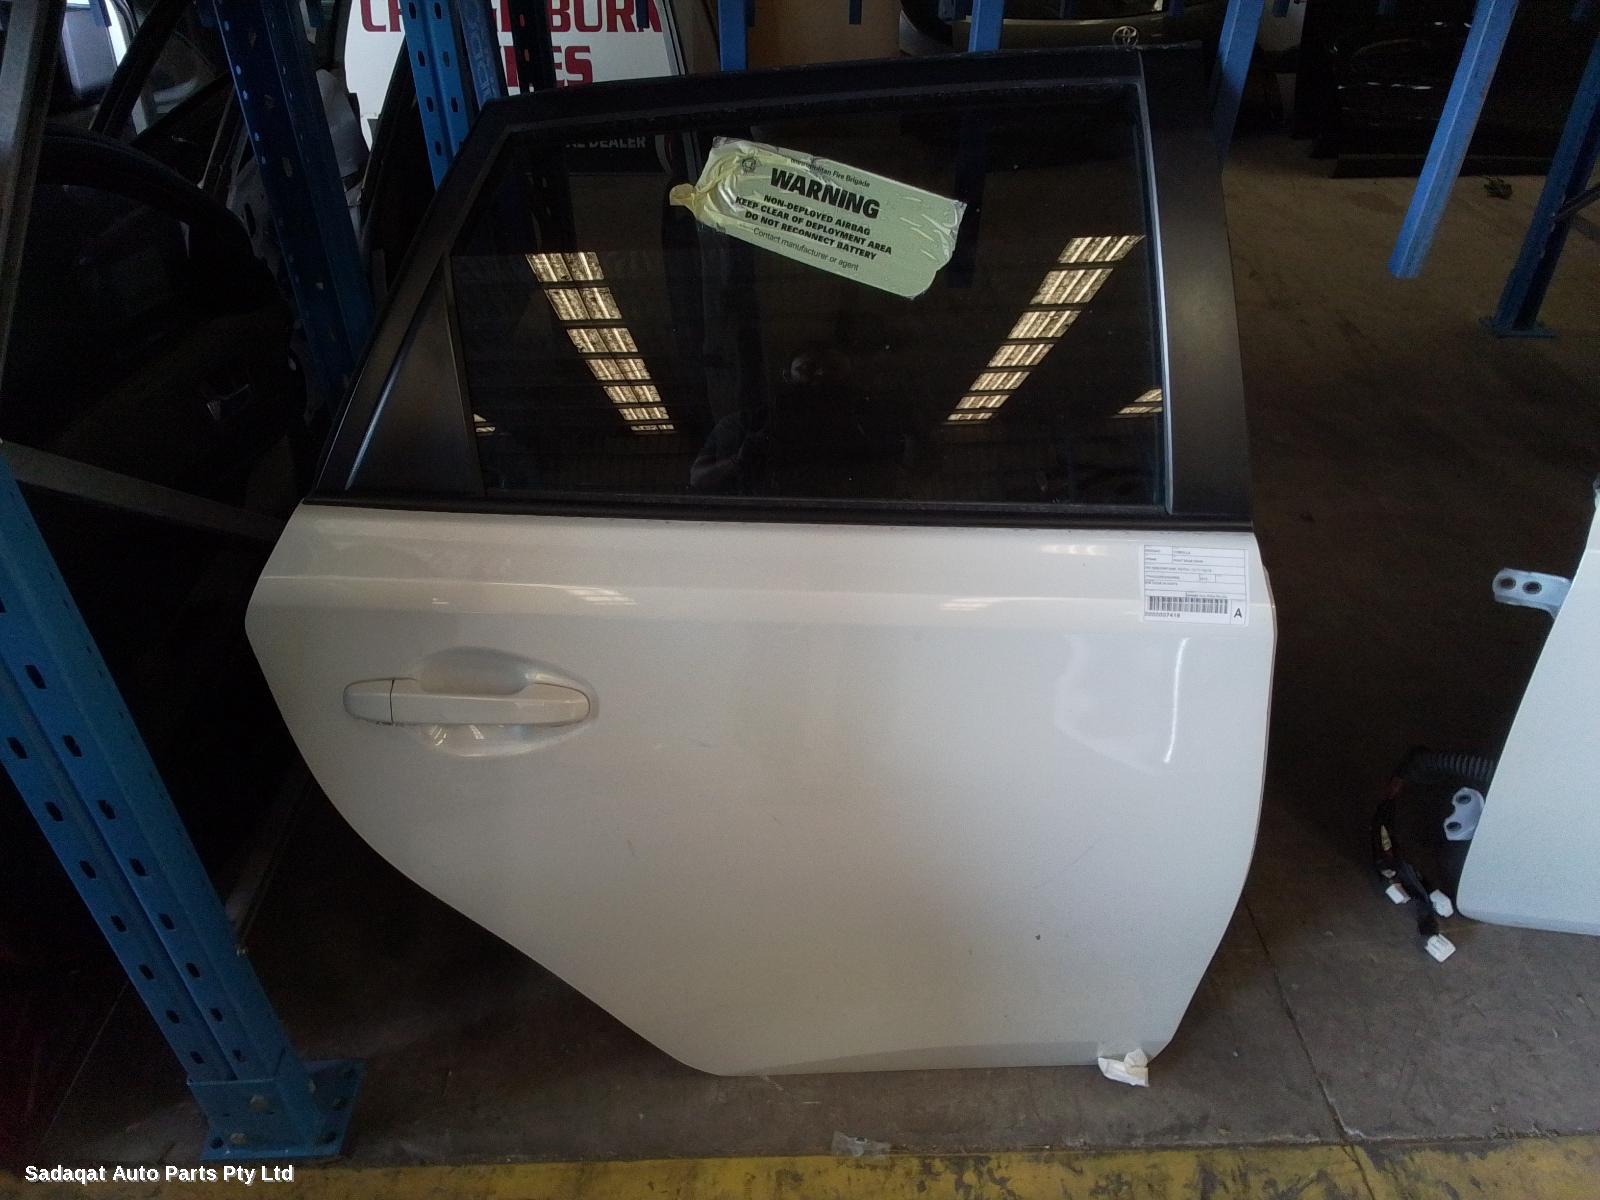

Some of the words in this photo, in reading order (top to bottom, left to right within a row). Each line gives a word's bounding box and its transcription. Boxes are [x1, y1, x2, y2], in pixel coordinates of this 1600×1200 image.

[770, 167, 881, 219] WARNING
[832, 170, 845, 180] Fire
[846, 174, 871, 188] Brigade
[735, 196, 759, 210] KEEP
[760, 204, 790, 220] CLEAR
[791, 214, 805, 225] OF
[805, 217, 866, 245] DEPLOYMENT
[867, 240, 892, 255] AREA
[745, 211, 758, 221] DO
[760, 216, 779, 230] NOT
[780, 223, 836, 247] RECONNECT
[837, 241, 877, 260] BATTERY
[763, 194, 834, 223] NON-DEPLOYED
[835, 216, 871, 236] AIRBAG
[753, 227, 780, 243] Contact
[781, 238, 829, 261] manufacturer
[829, 255, 837, 263] or
[838, 258, 859, 271] agent
[1233, 607, 1243, 618] A
